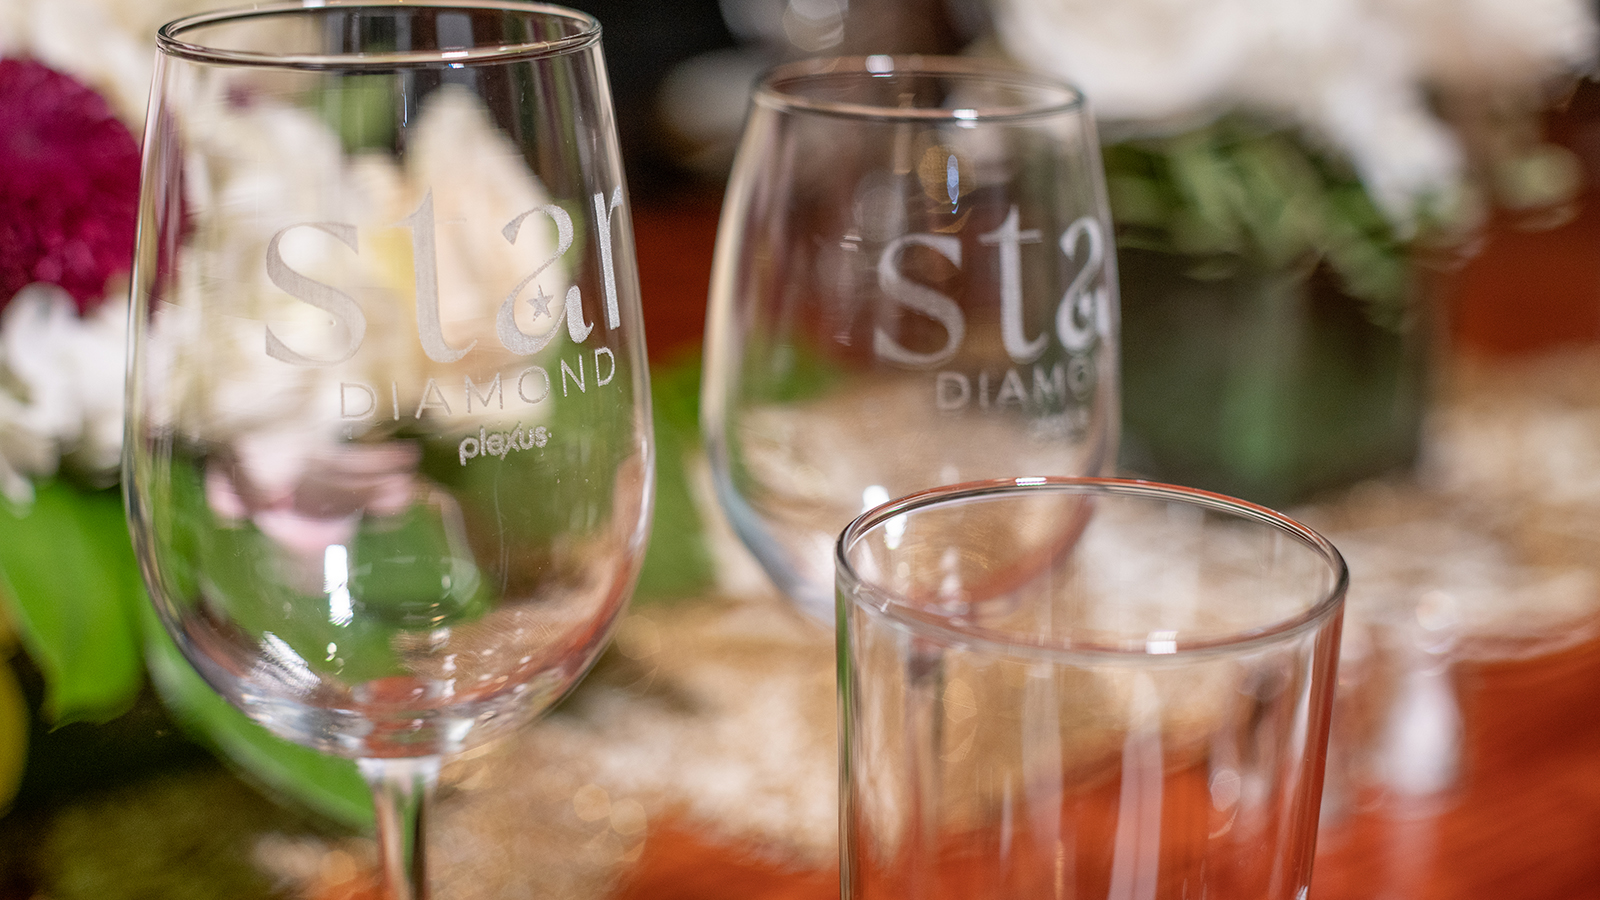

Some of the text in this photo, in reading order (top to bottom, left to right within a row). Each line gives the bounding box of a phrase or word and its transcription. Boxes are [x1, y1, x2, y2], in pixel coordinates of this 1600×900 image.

[265, 185, 622, 366] star
[339, 346, 616, 421] DIAMOND
[458, 422, 549, 466] plexus
